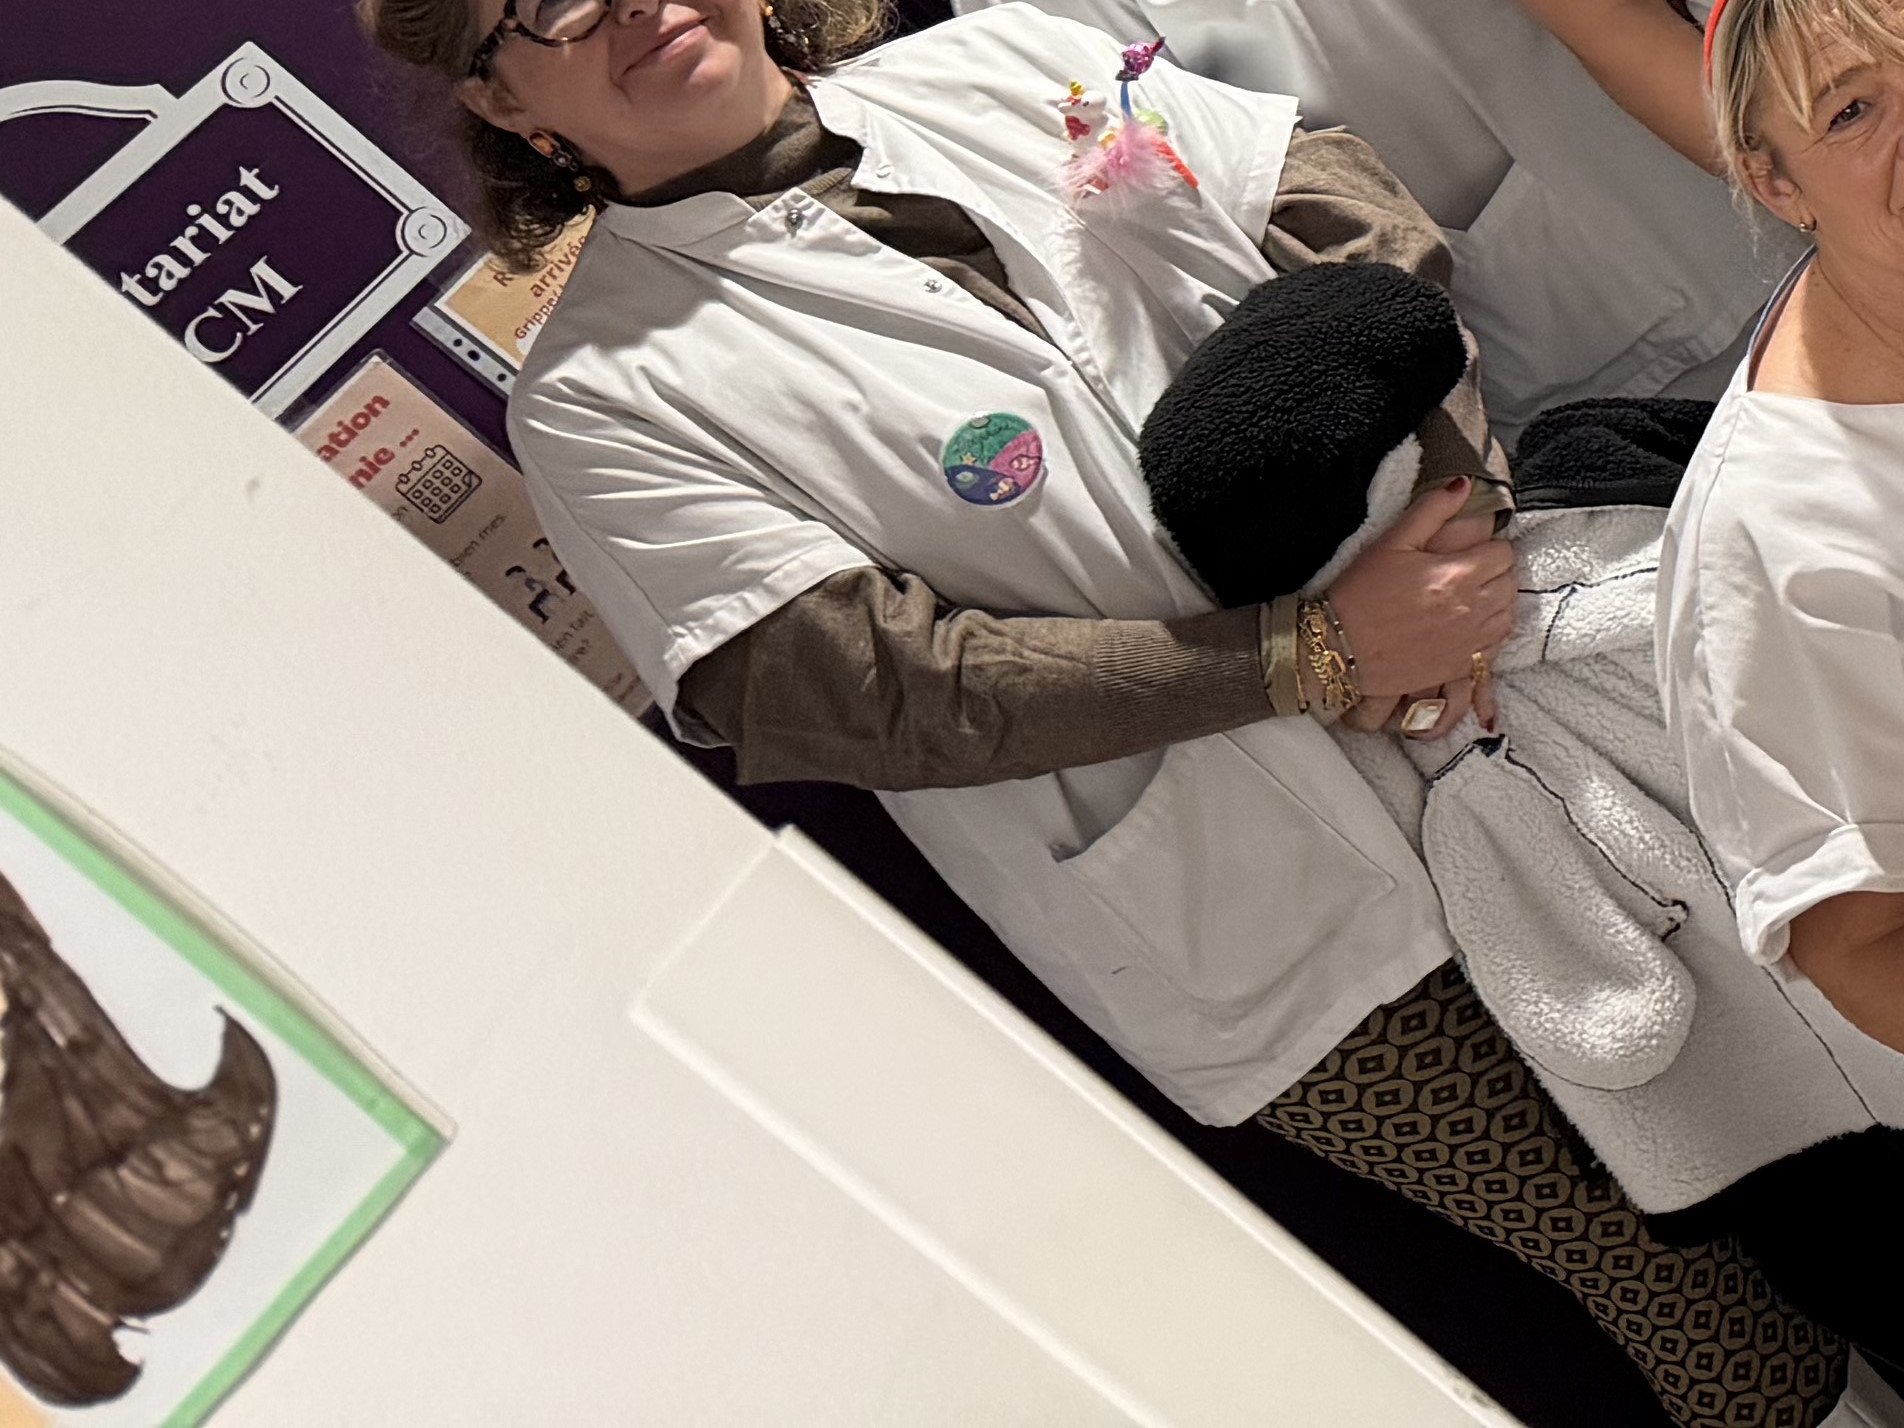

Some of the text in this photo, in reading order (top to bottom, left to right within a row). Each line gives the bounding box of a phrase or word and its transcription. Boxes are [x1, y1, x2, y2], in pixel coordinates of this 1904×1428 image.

[119, 165, 281, 307] tariat
[183, 254, 304, 364] CM
[316, 394, 391, 463] ation
